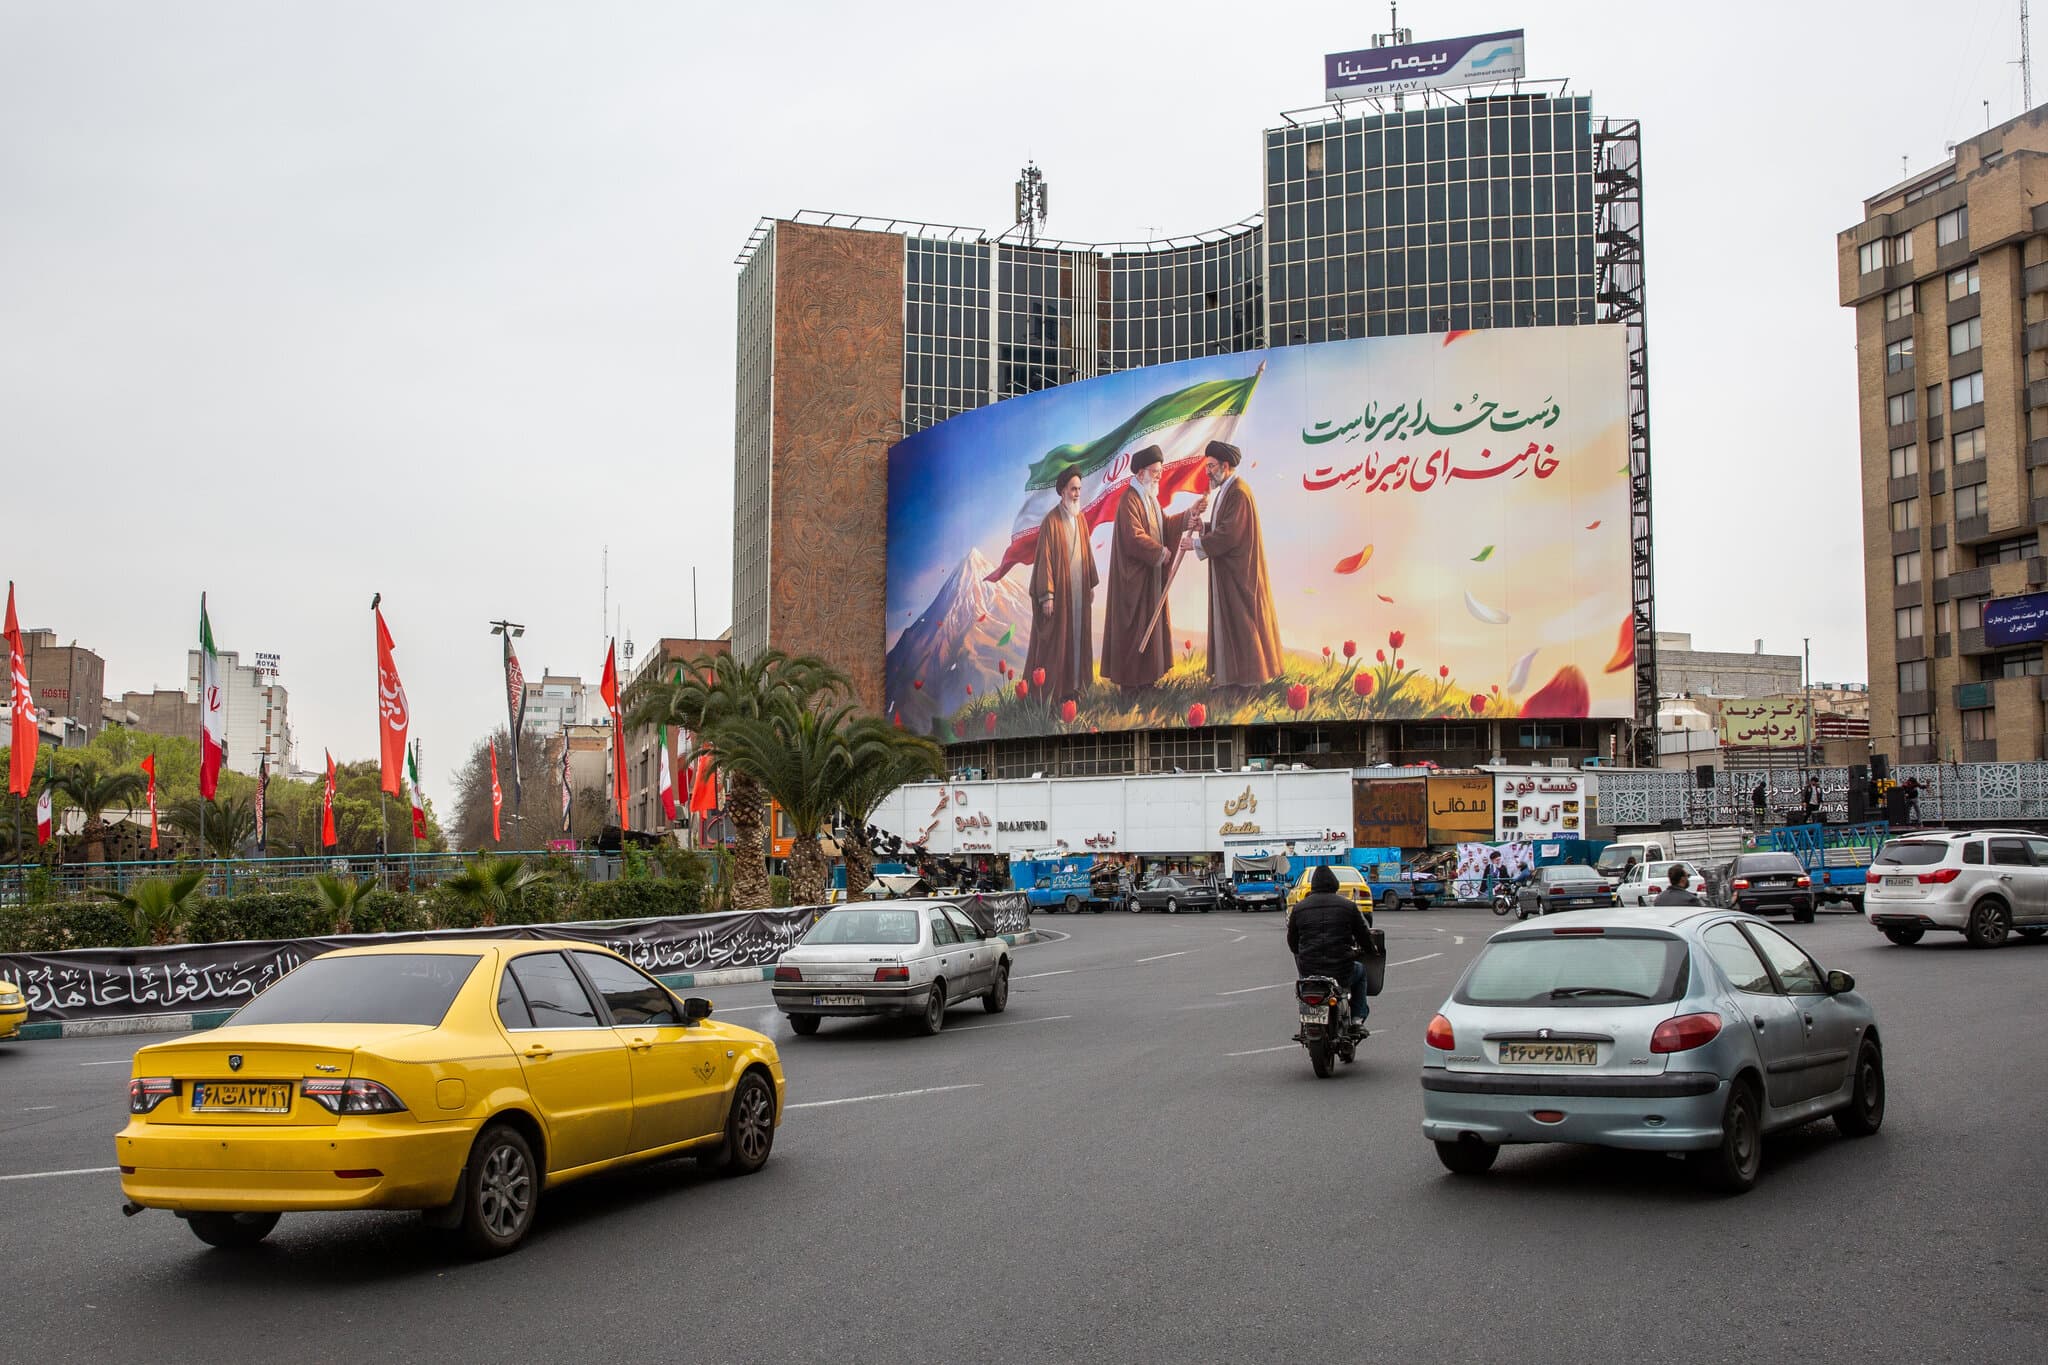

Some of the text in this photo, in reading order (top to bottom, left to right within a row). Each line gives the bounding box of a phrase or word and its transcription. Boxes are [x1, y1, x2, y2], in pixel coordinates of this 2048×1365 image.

[1337, 53, 1448, 81] بیمه سینا
[255, 652, 281, 660] TEHRAN
[256, 660, 279, 668] ROYAL
[255, 668, 280, 676] HOTEL
[1726, 703, 1767, 720] خرید
[1737, 723, 1798, 741] پردیس
[1504, 775, 1579, 797] فست فود
[1520, 803, 1561, 825] آرام
[1501, 831, 1524, 841] VIP
